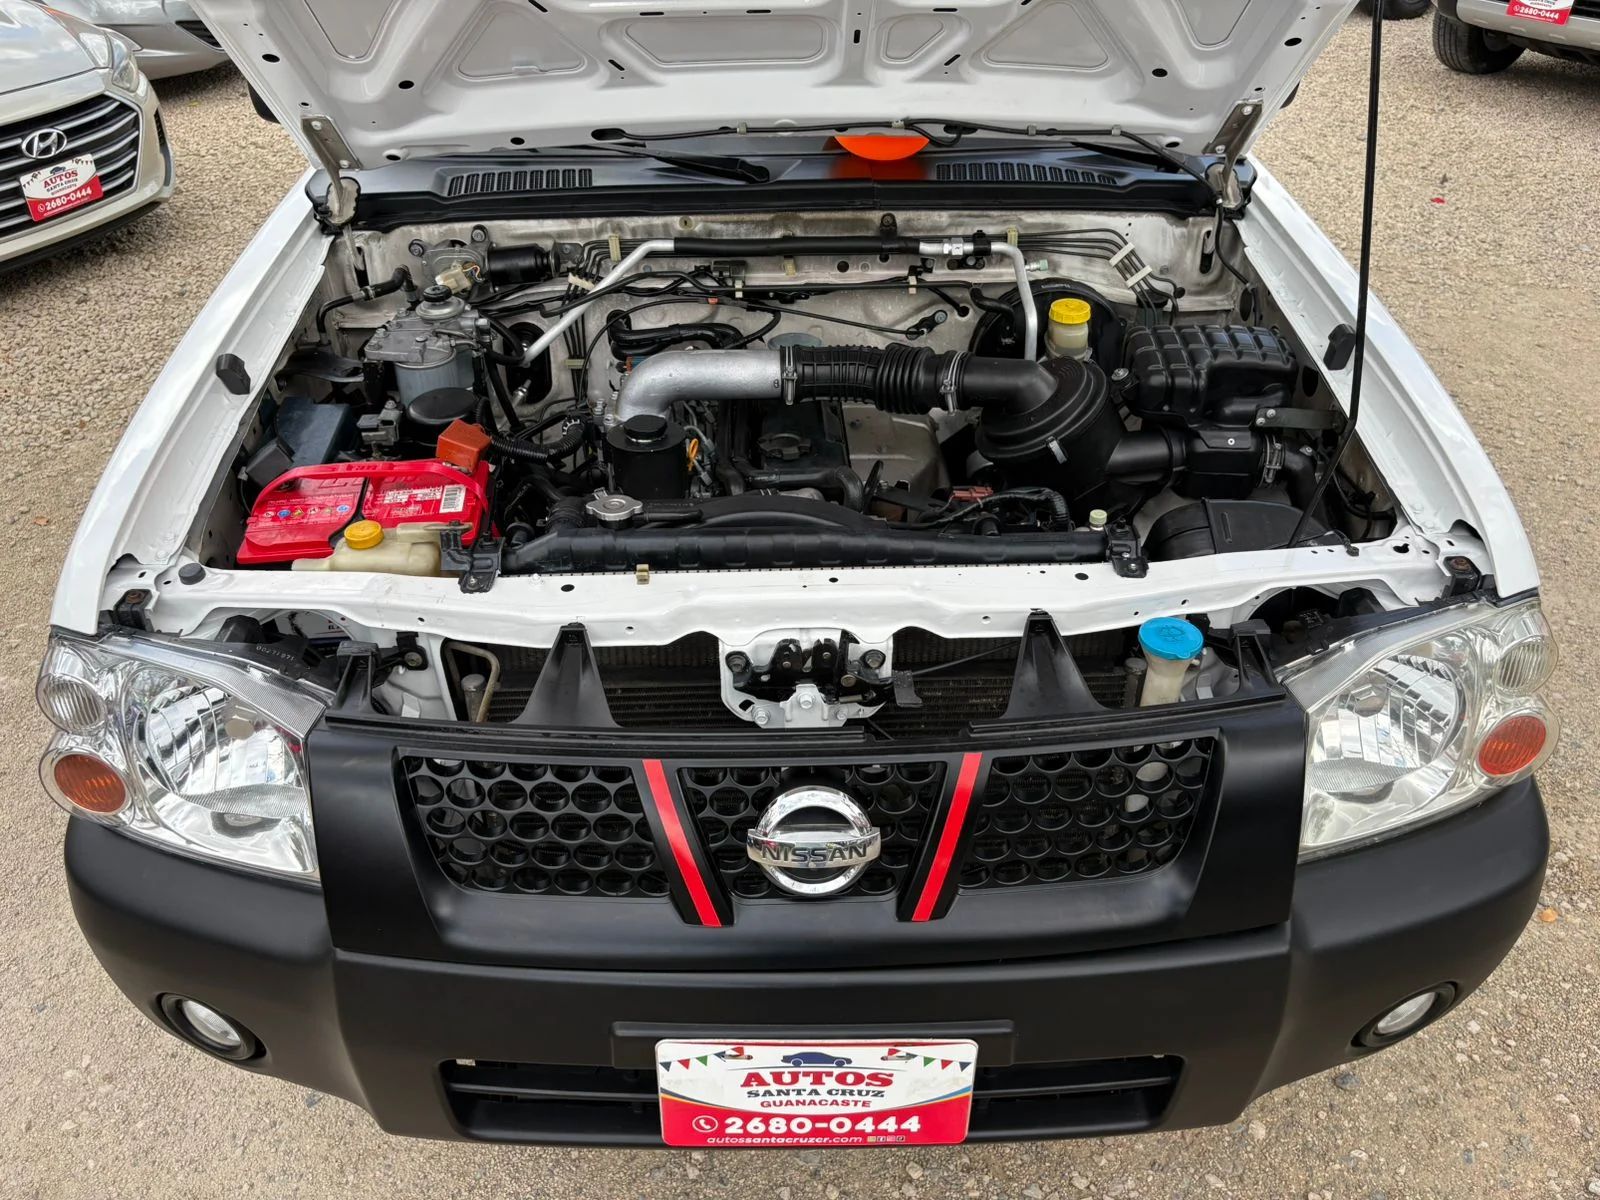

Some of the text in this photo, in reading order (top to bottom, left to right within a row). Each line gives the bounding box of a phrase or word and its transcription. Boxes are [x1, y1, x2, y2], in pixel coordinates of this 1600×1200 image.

[1519, 6, 1559, 19] 2680-0444
[44, 170, 78, 187] AUTOS
[45, 187, 92, 210] 2680-0444
[762, 843, 867, 862] NISSAN
[740, 1070, 894, 1088] AUTOS
[747, 1088, 885, 1098] SANTA CRUZ
[760, 1099, 872, 1108] GUANACASTE
[724, 1115, 921, 1134] 2680-0444
